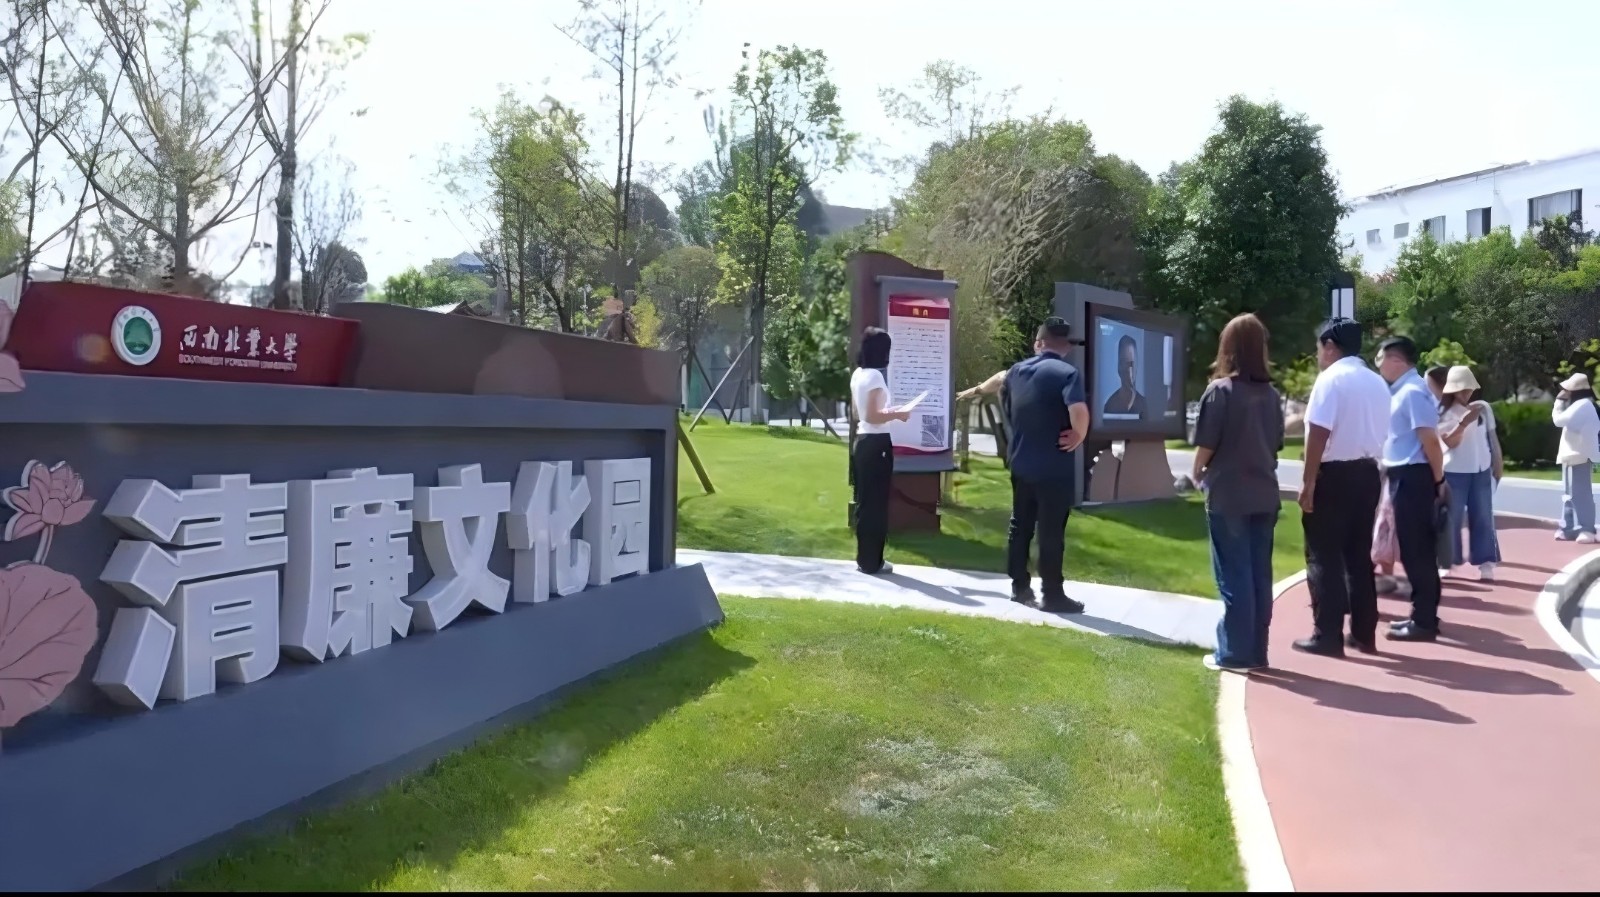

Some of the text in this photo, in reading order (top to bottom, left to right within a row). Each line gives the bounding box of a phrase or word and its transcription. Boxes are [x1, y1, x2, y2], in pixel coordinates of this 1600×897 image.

[93, 457, 652, 710] 清廉文化园
